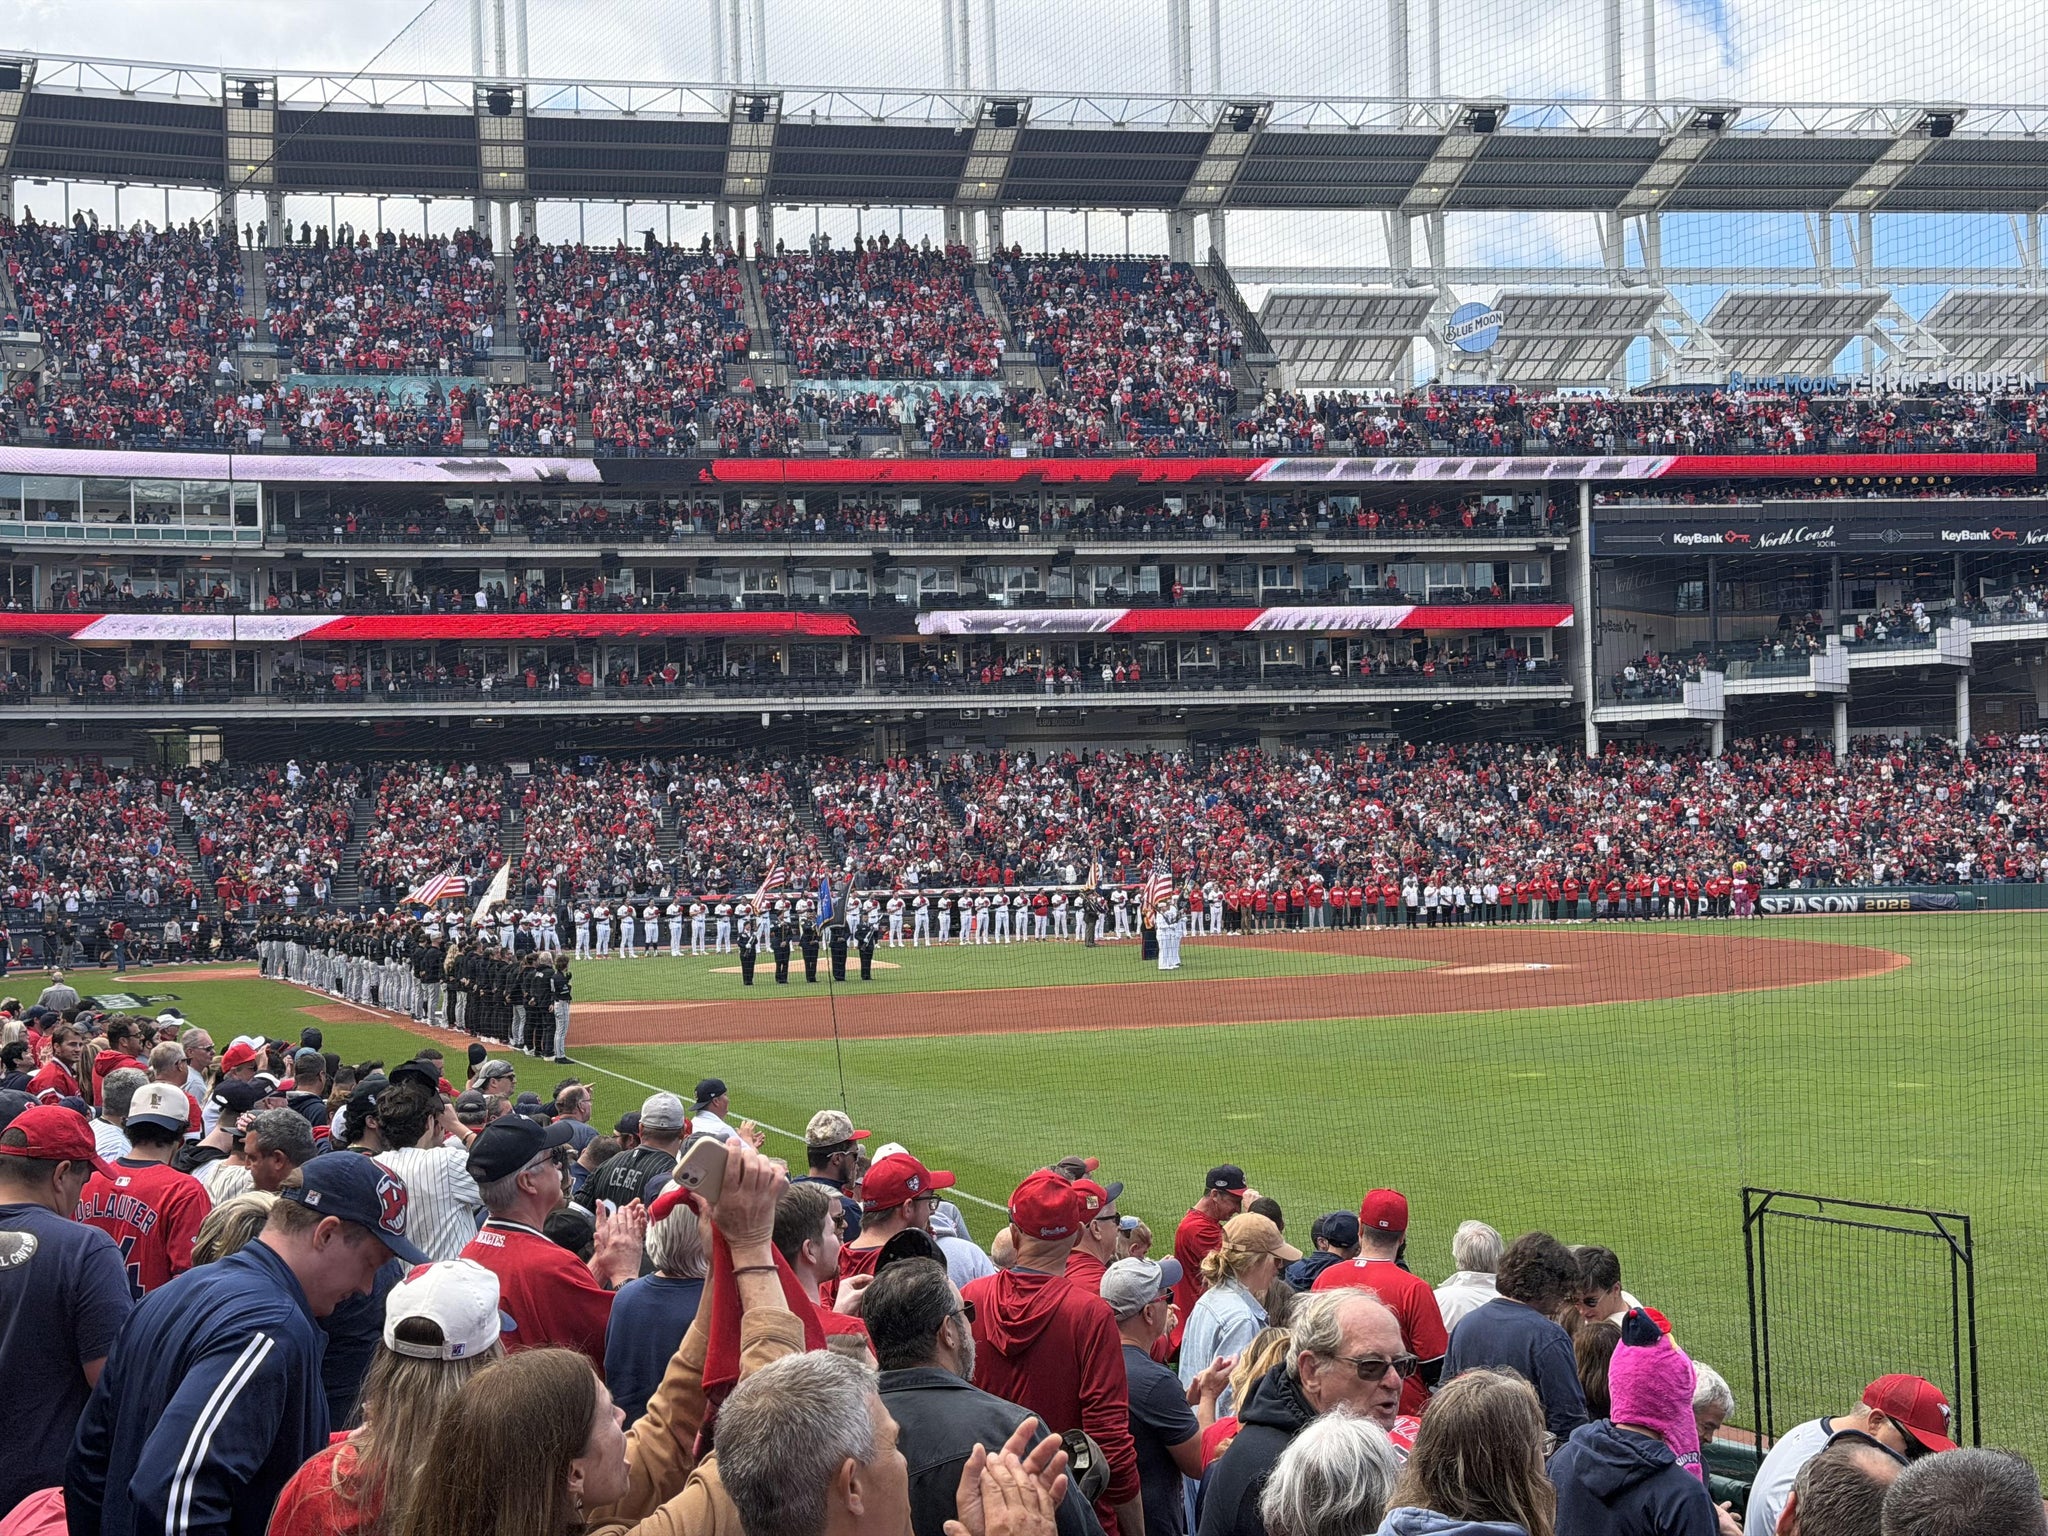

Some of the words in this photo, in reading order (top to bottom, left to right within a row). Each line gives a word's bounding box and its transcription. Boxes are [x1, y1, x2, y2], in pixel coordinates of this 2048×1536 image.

[1475, 313, 1502, 330] MOON
[1783, 375, 1838, 393] MOON
[1948, 371, 2035, 393] GARDEN
[1673, 532, 1724, 546] KeyBank
[1750, 532, 1796, 549] North
[1795, 525, 1834, 542] Coast
[1941, 530, 1990, 542] KeyBank
[75, 1192, 159, 1235] DeLAUTER
[10, 1243, 33, 1265] GAVE
